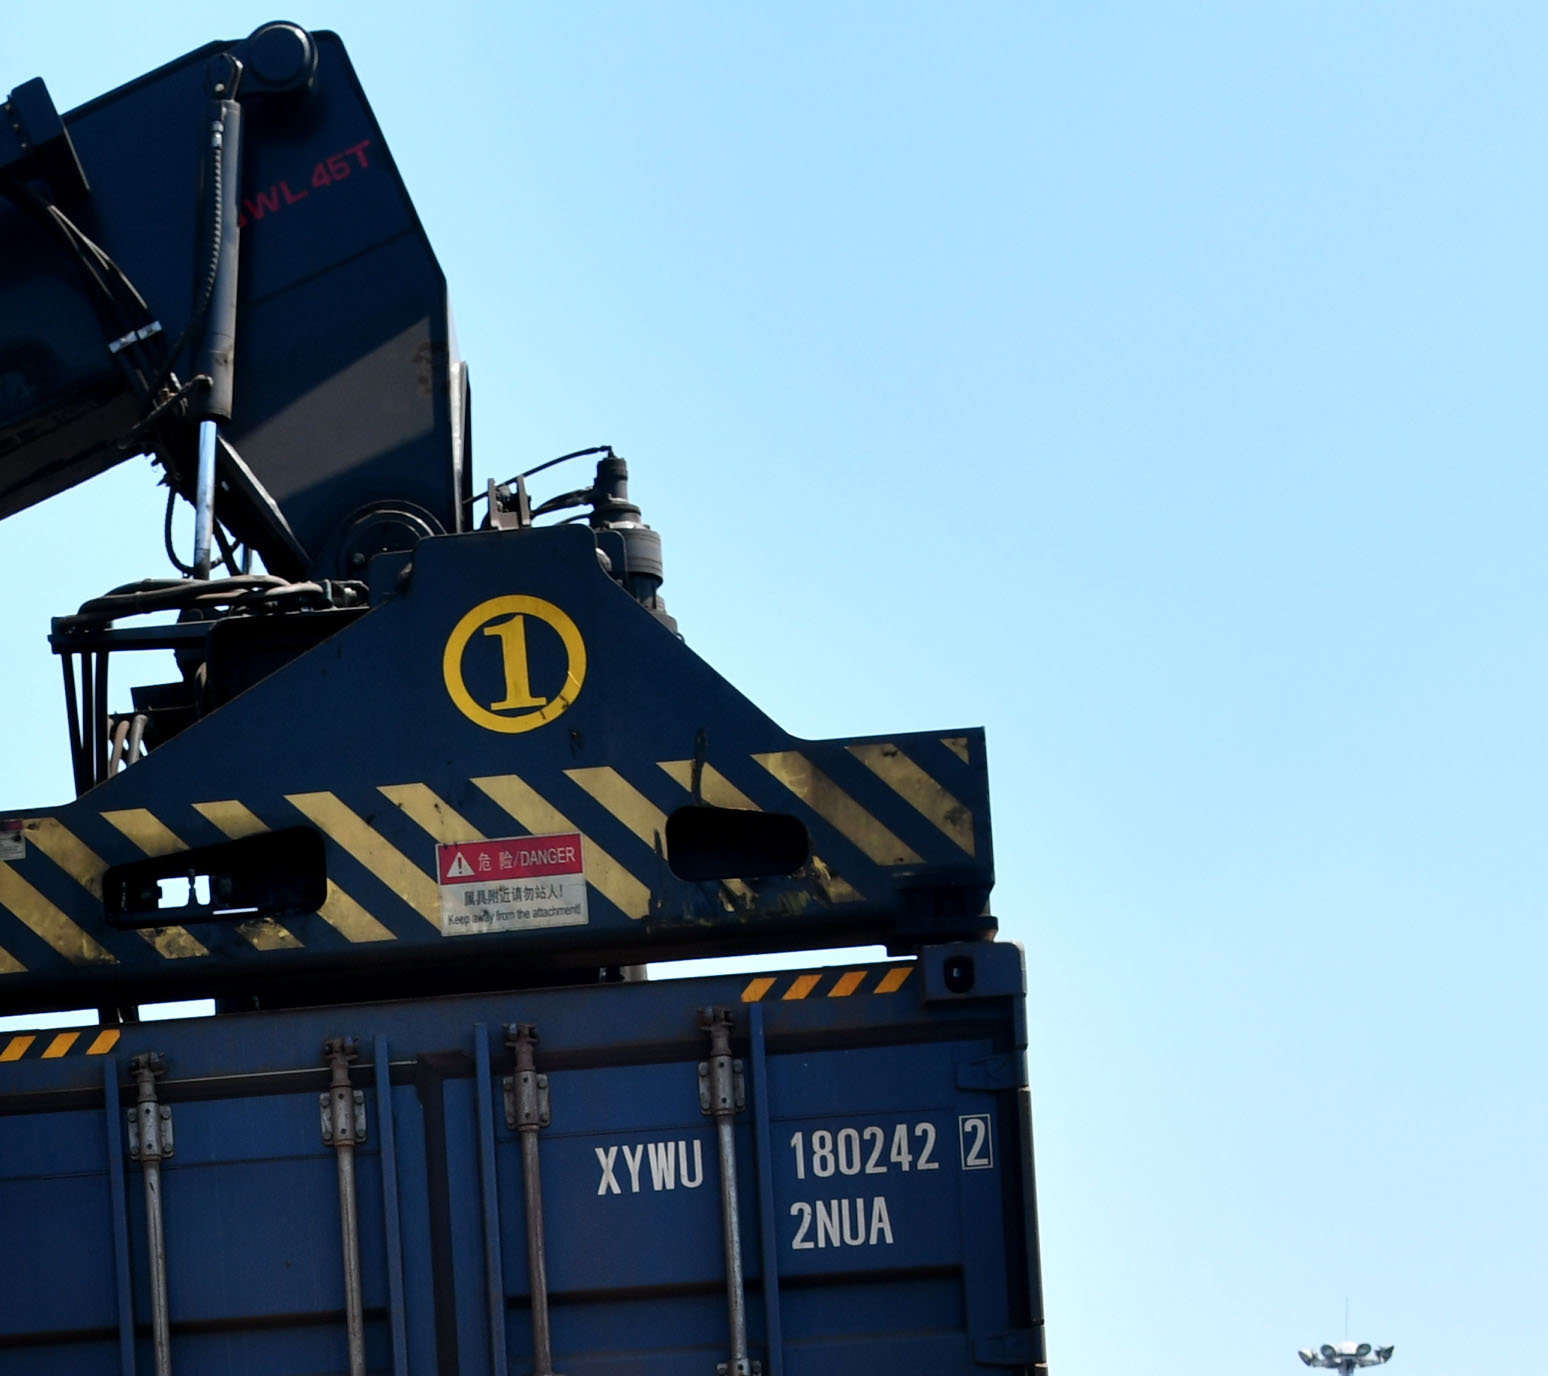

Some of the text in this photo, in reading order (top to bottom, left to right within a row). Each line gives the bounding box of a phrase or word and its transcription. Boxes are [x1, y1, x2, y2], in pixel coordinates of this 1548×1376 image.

[312, 139, 371, 188] 45T
[448, 914, 470, 926] Keep
[472, 911, 494, 925] away
[496, 910, 515, 922] from
[516, 908, 531, 920] the
[595, 1116, 990, 1195] XYWU 180242 2
[790, 1196, 894, 1249] 2NUA
